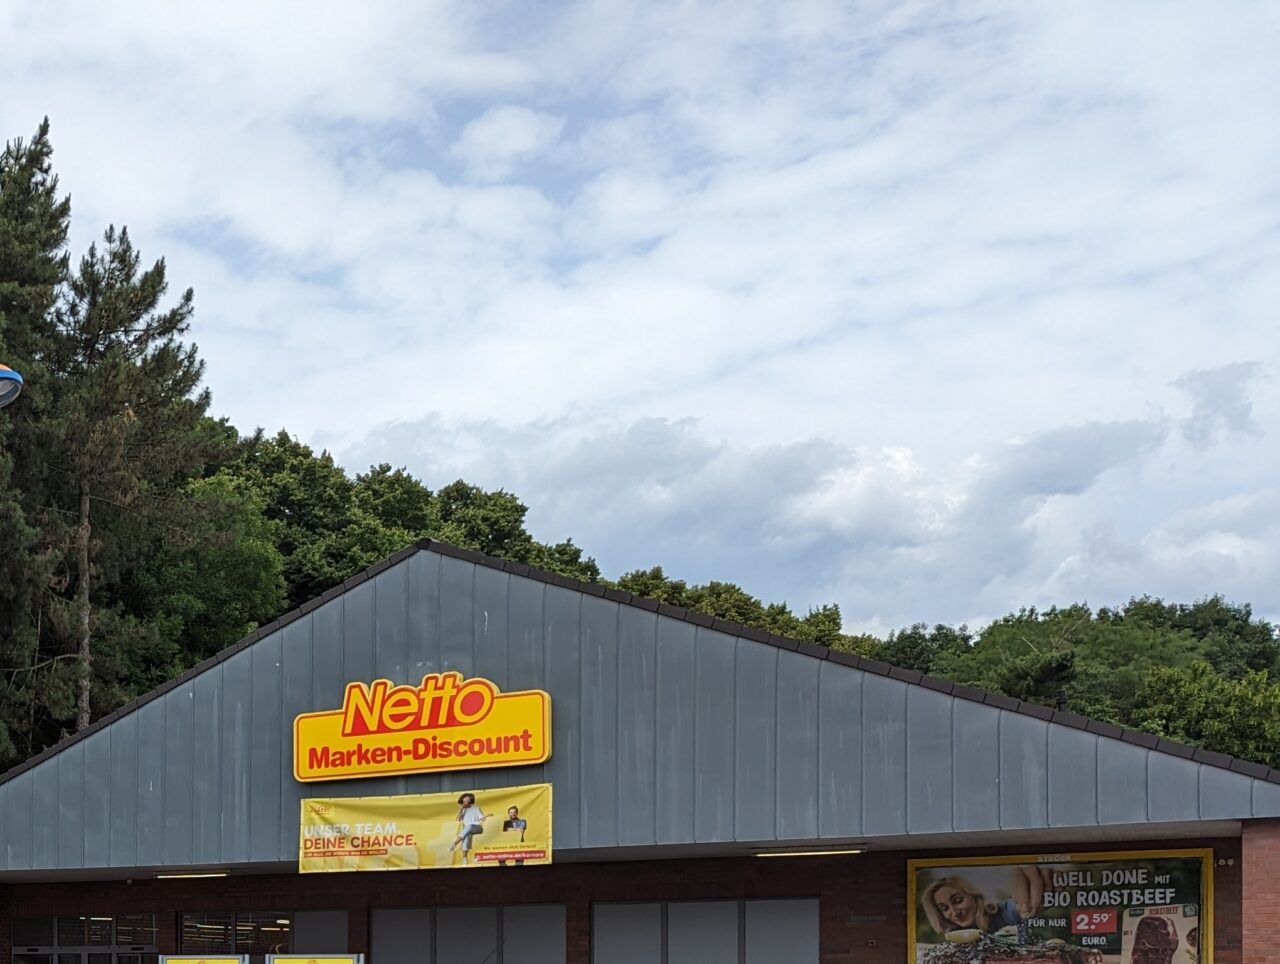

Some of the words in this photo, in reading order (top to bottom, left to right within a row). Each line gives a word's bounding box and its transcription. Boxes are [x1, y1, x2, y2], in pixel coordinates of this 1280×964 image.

[344, 677, 494, 735] Netto
[308, 729, 533, 770] Marken-Discount
[304, 824, 350, 836] UNSER
[355, 822, 400, 835] TEAM.
[304, 837, 346, 850] DEINE
[350, 834, 417, 849] CHANCE.
[1052, 871, 1095, 888] WELL
[1101, 869, 1149, 886] DONE
[1154, 875, 1171, 884] MIT
[1043, 891, 1071, 907] BIO
[1076, 888, 1176, 906] ROASTBEEF
[1027, 919, 1046, 928] FÜR
[1048, 918, 1067, 927] NUR
